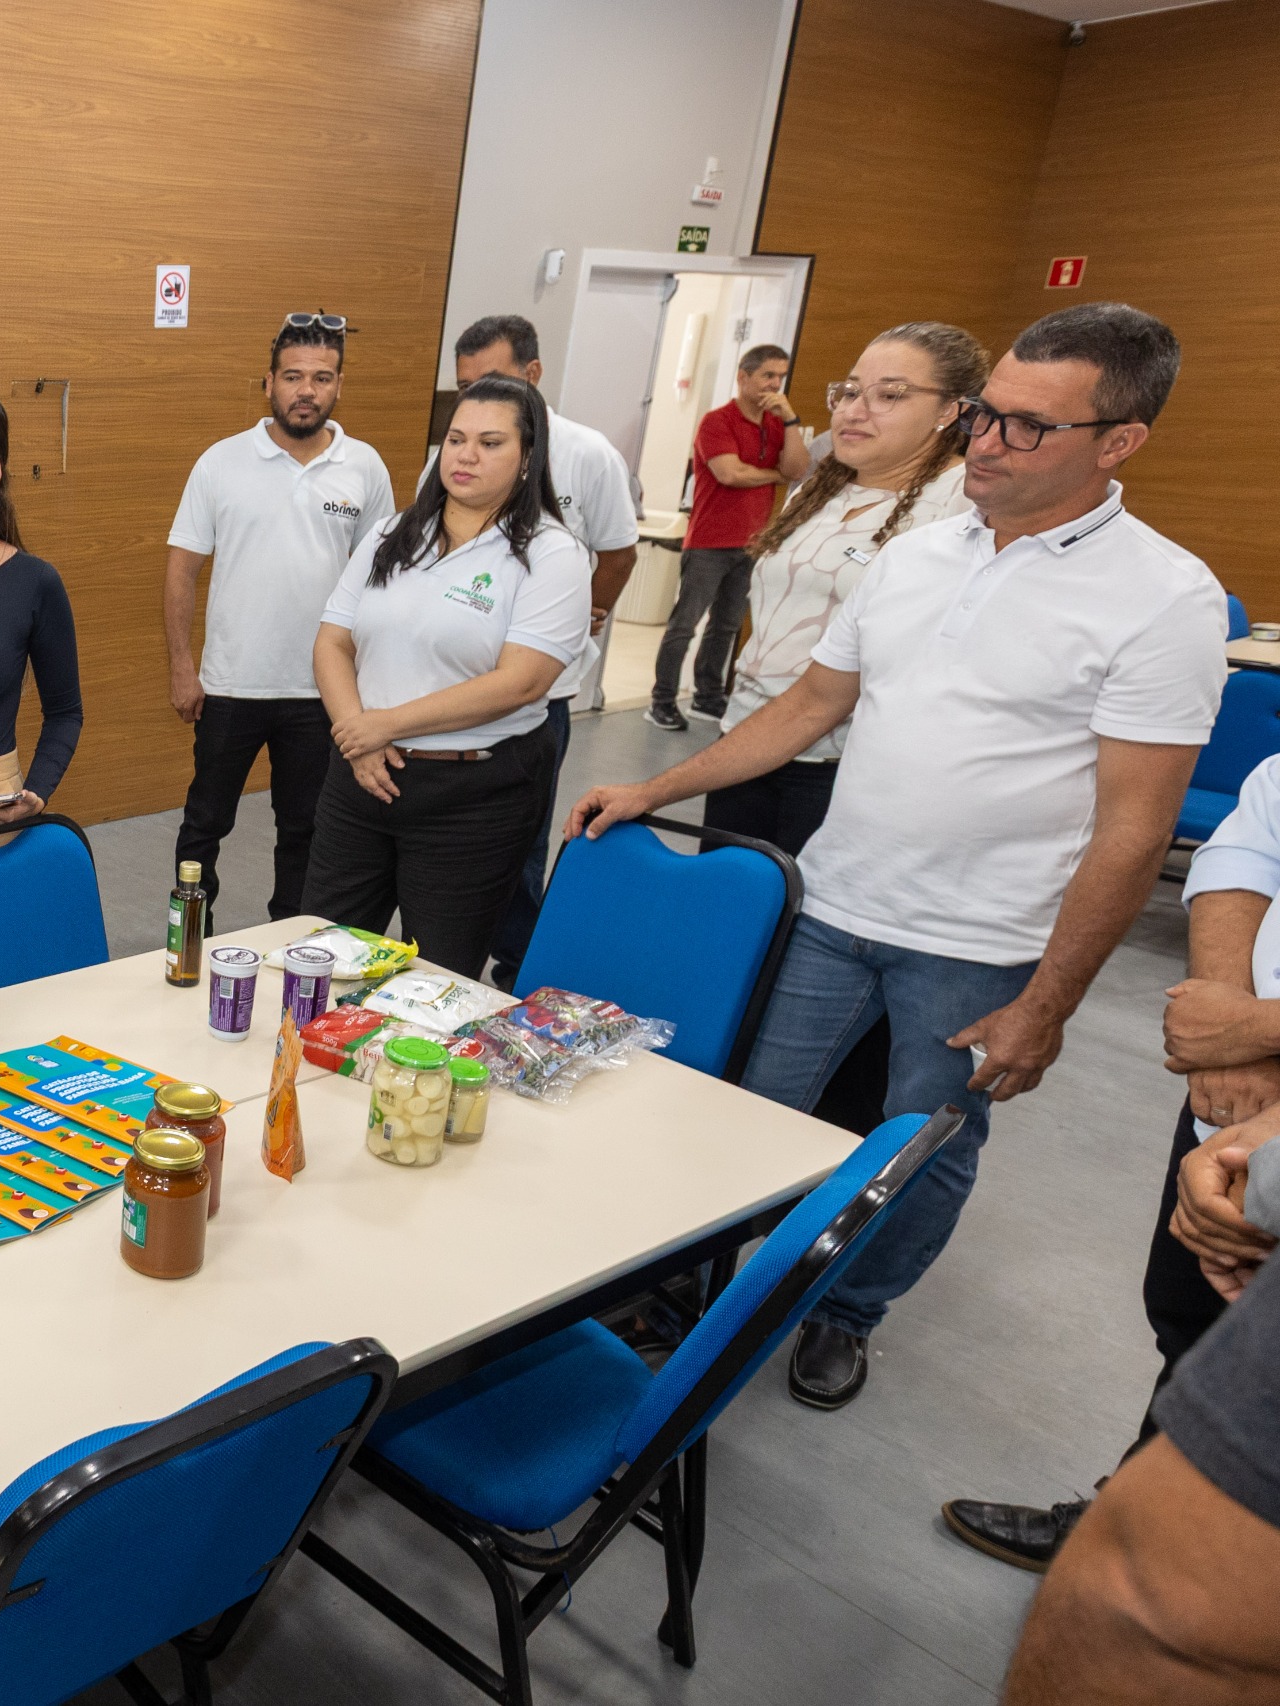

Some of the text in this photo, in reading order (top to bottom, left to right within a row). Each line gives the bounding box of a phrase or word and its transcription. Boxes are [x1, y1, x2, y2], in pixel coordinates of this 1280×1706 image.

[680, 227, 708, 243] SAÍDA
[323, 500, 360, 518] abrinco
[363, 1048, 380, 1061] Beij
[42, 1074, 87, 1090] CATÁLOGO
[49, 1077, 96, 1093] PRODUTOS
[58, 1077, 119, 1097] AGRICULTURA
